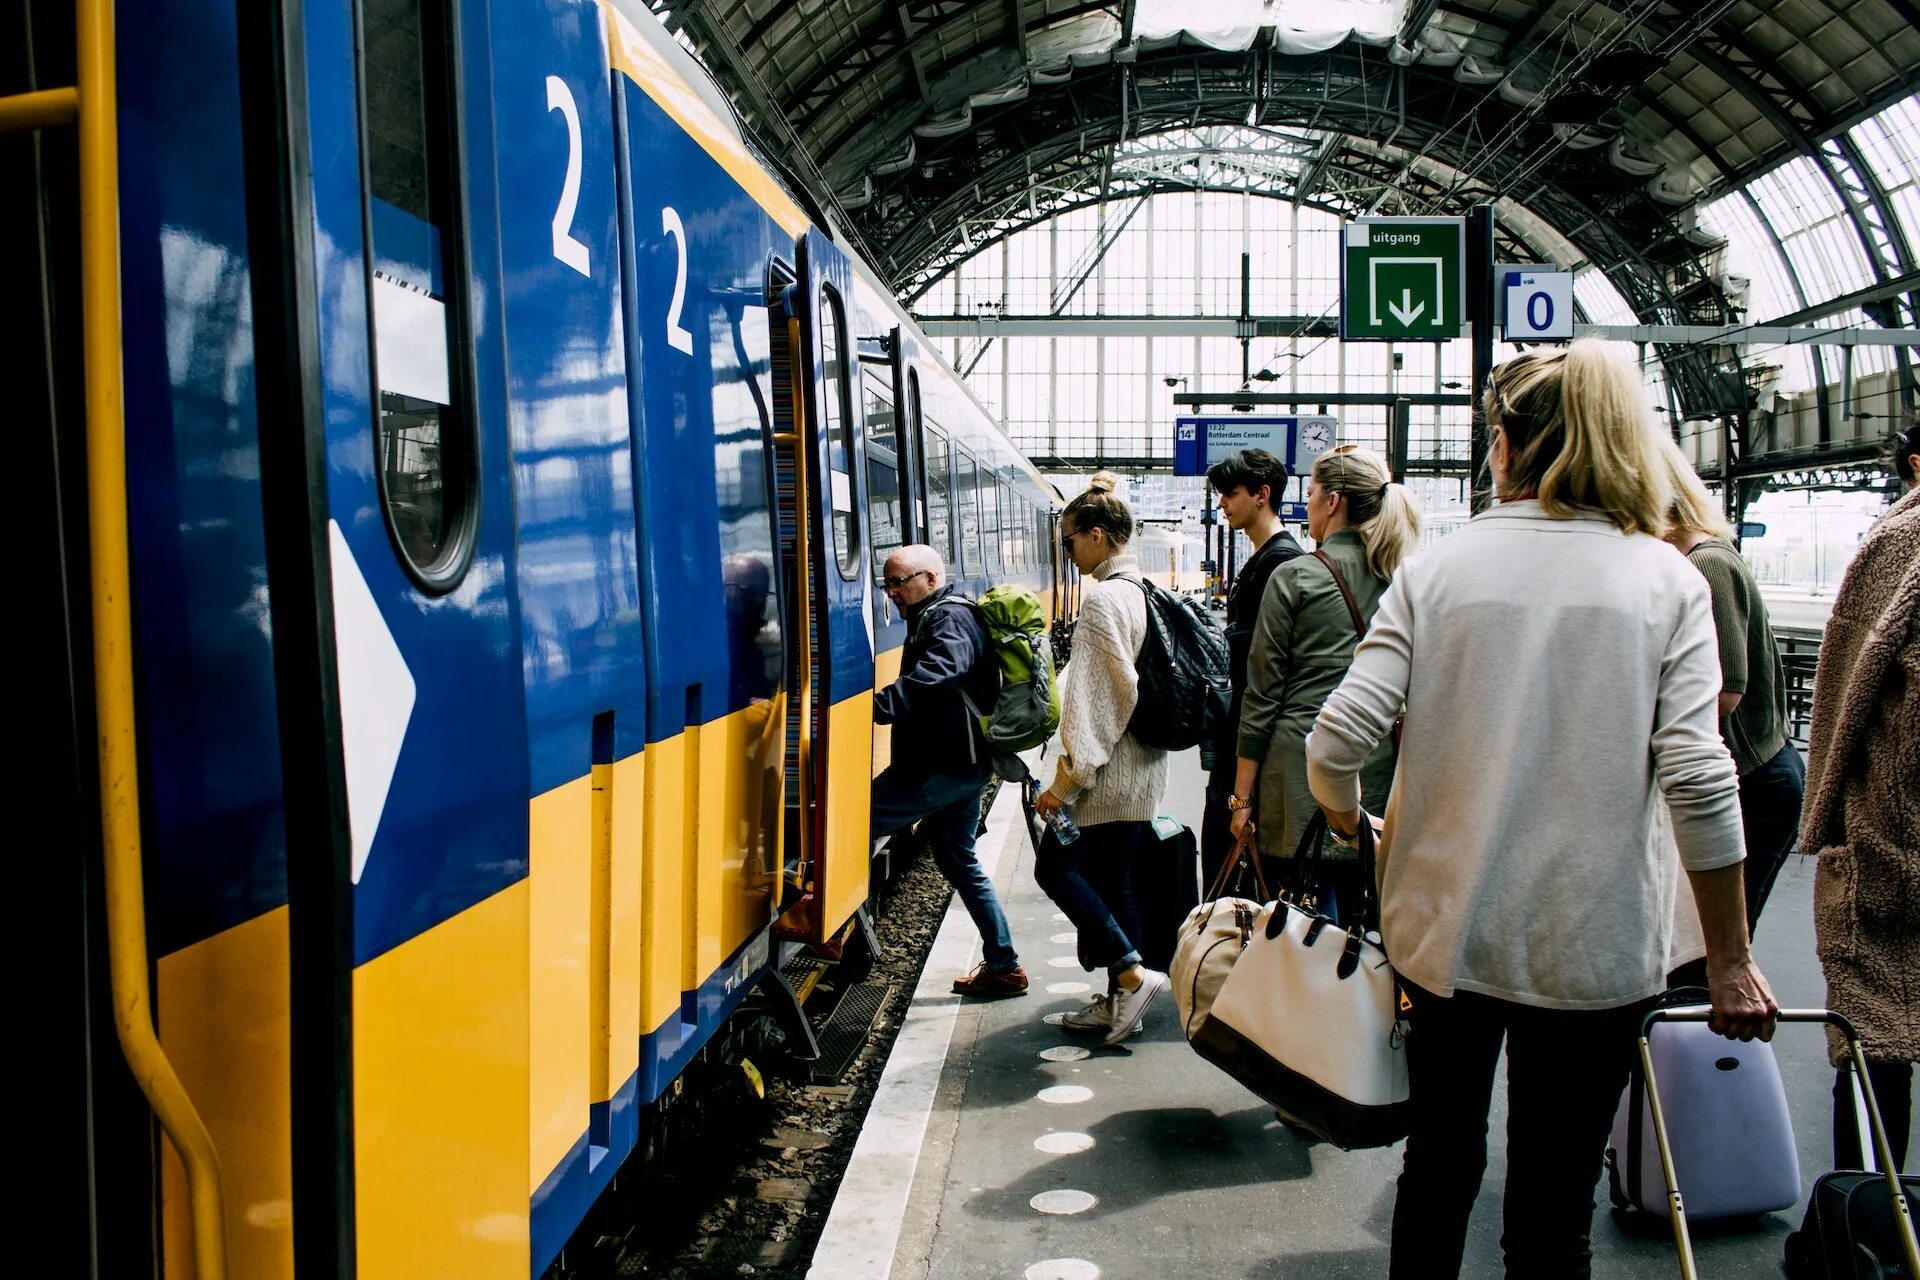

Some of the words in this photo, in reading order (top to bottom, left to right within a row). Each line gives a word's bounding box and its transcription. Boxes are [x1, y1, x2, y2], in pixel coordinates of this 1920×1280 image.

[546, 75, 591, 279] 2
[662, 206, 693, 357] 2
[1373, 232, 1420, 245] uitgang
[1527, 291, 1554, 331] 0
